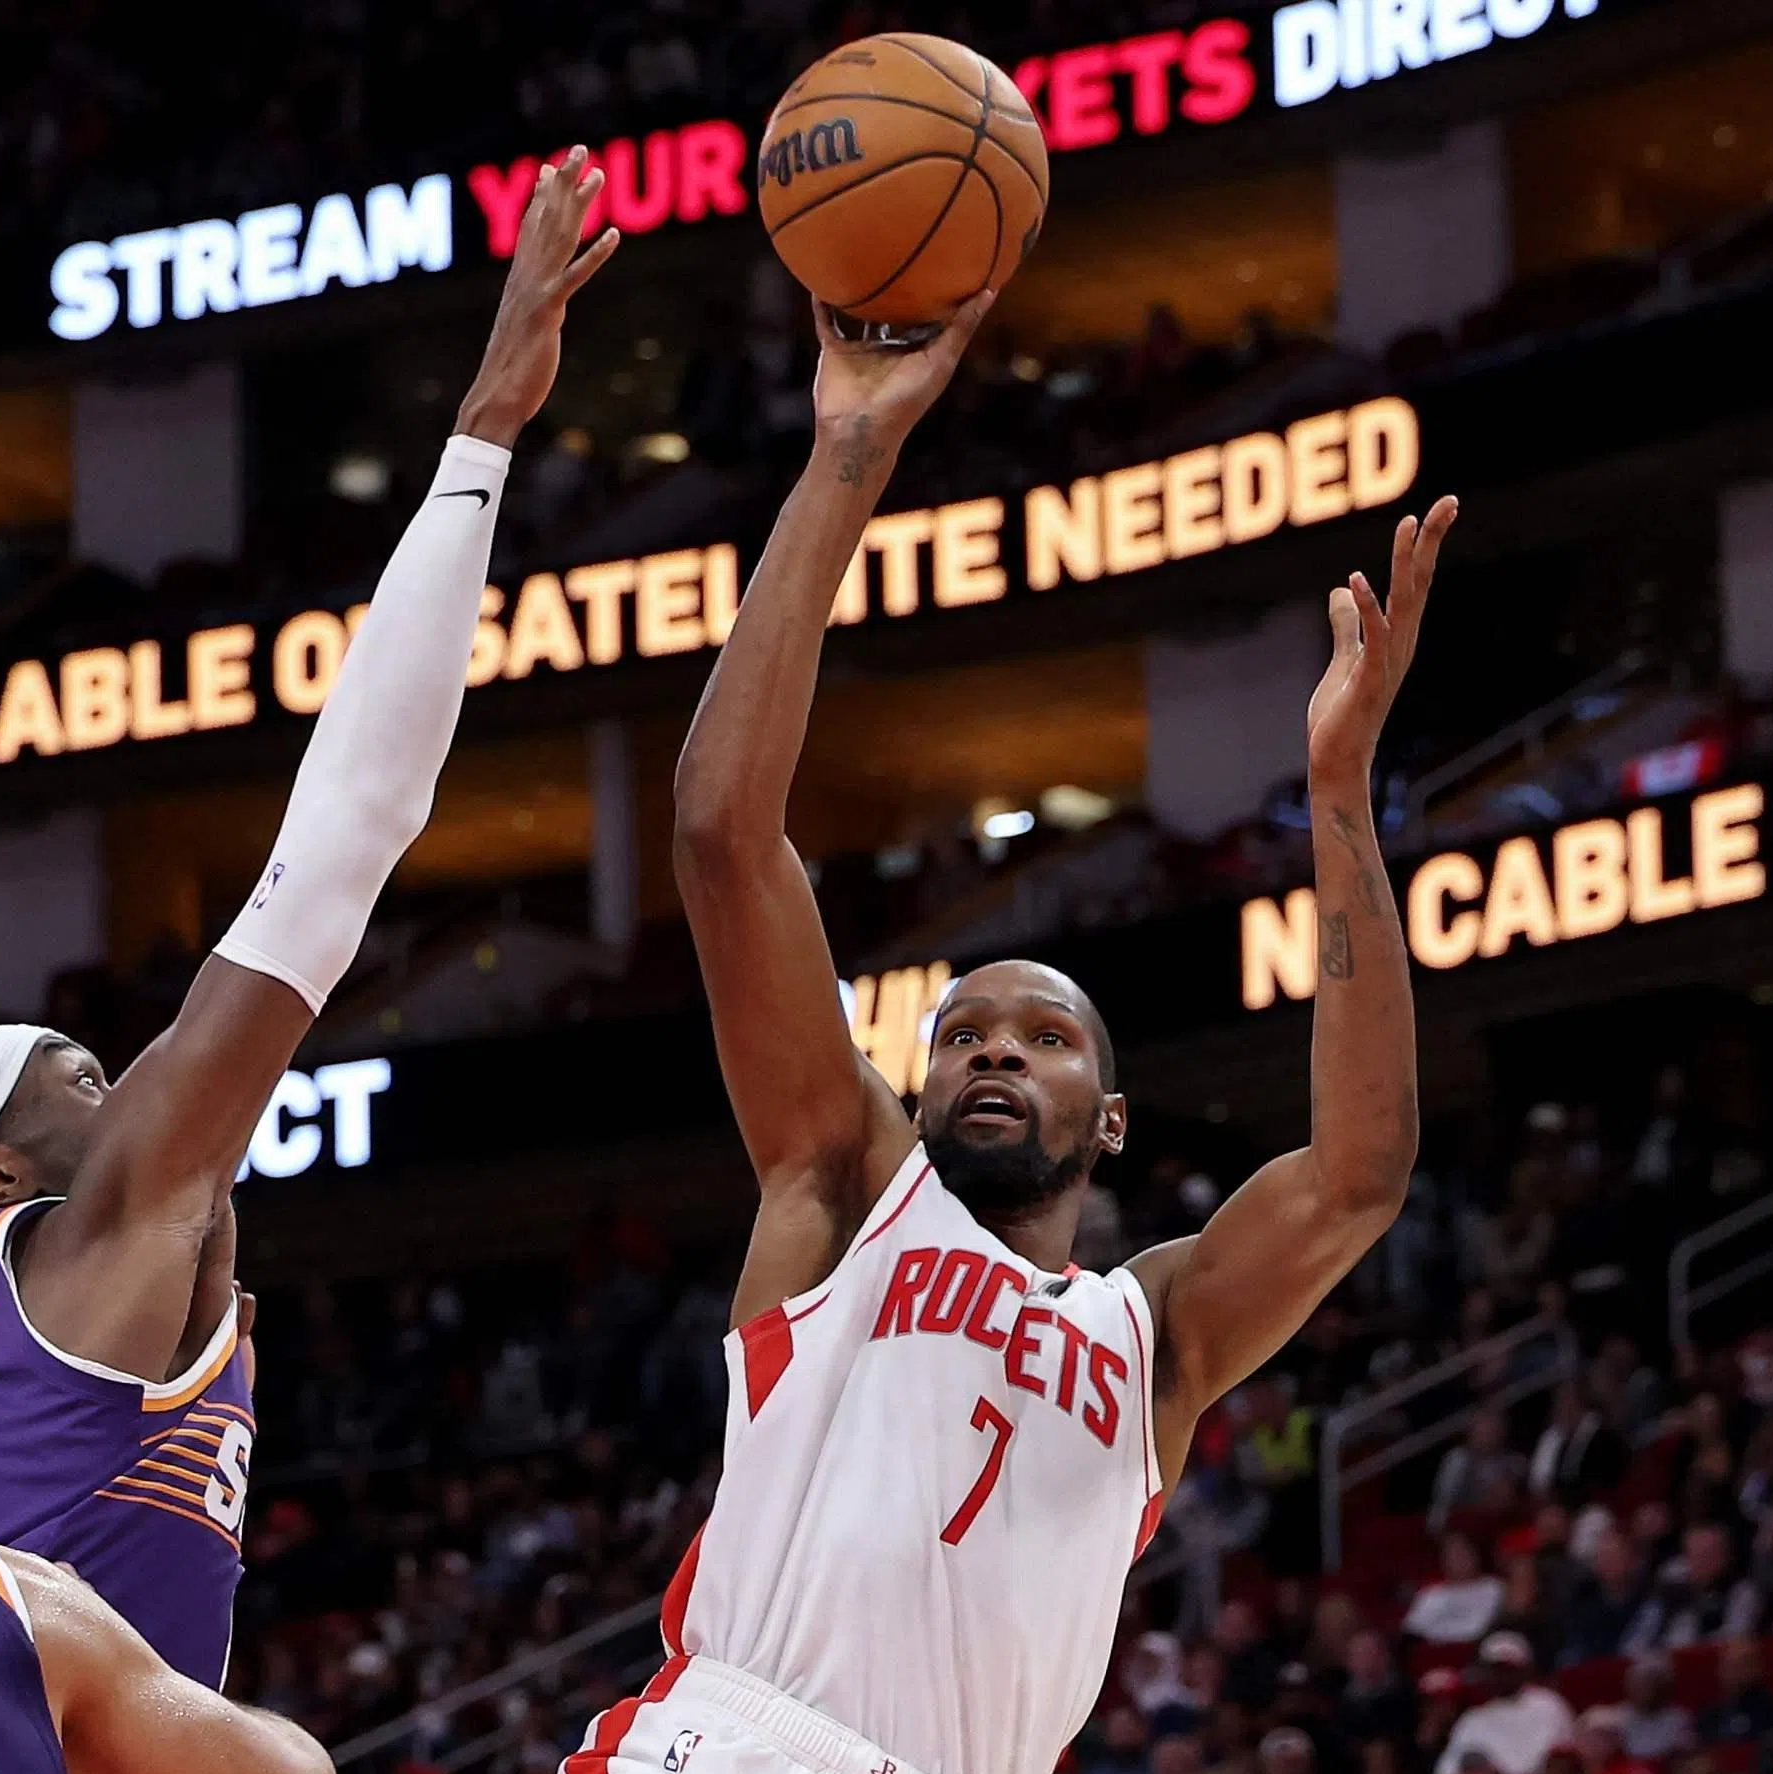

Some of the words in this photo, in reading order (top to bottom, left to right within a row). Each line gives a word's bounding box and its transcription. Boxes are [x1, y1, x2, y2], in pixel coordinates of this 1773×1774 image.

[48, 174, 453, 340] STREAM
[273, 602, 369, 715] O
[1024, 396, 1421, 593] NEEDED
[1240, 888, 1317, 1010] N
[1406, 783, 1767, 970] CABLE
[868, 1246, 1128, 1450] ROCETS
[940, 1395, 1014, 1546] 7
